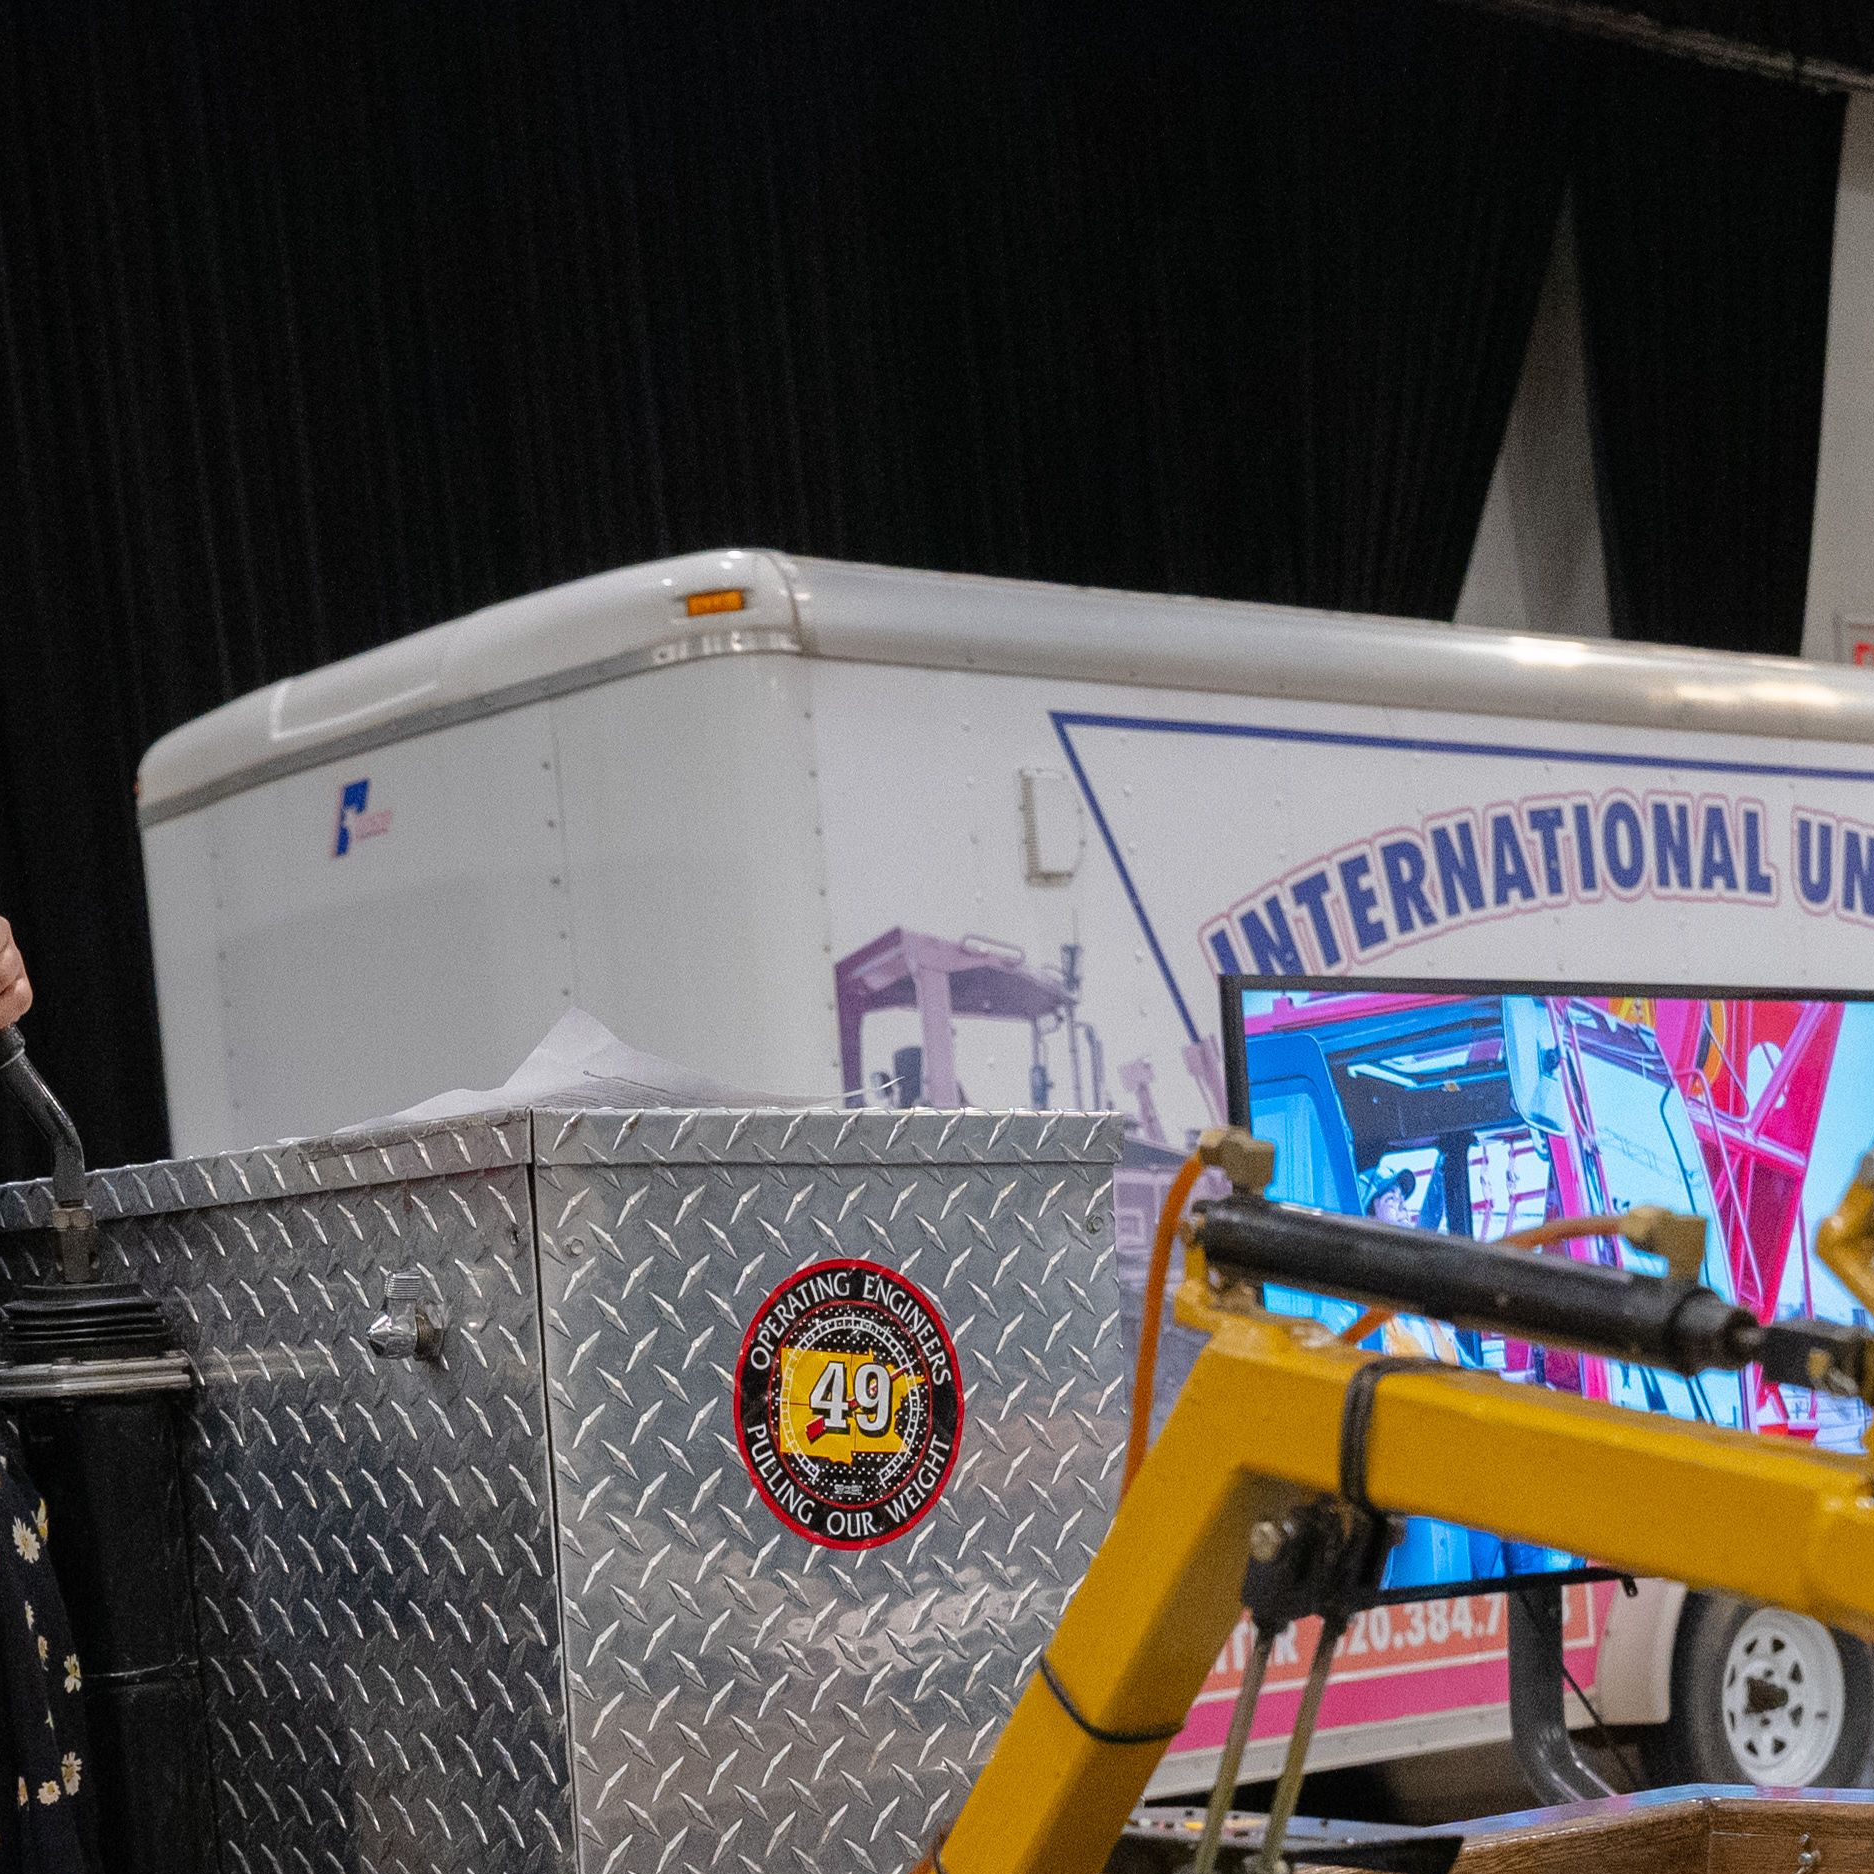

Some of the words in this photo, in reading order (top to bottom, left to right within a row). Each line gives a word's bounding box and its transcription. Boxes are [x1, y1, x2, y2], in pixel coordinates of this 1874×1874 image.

[1208, 799, 1774, 976] INTERNATIONAL
[750, 1271, 851, 1371] OPERATING
[862, 1272, 953, 1387] ENGINEERS
[808, 1360, 893, 1433] 49
[746, 1422, 817, 1526] PULLING
[825, 1510, 878, 1538] OUR
[883, 1433, 952, 1524] WEIGHT
